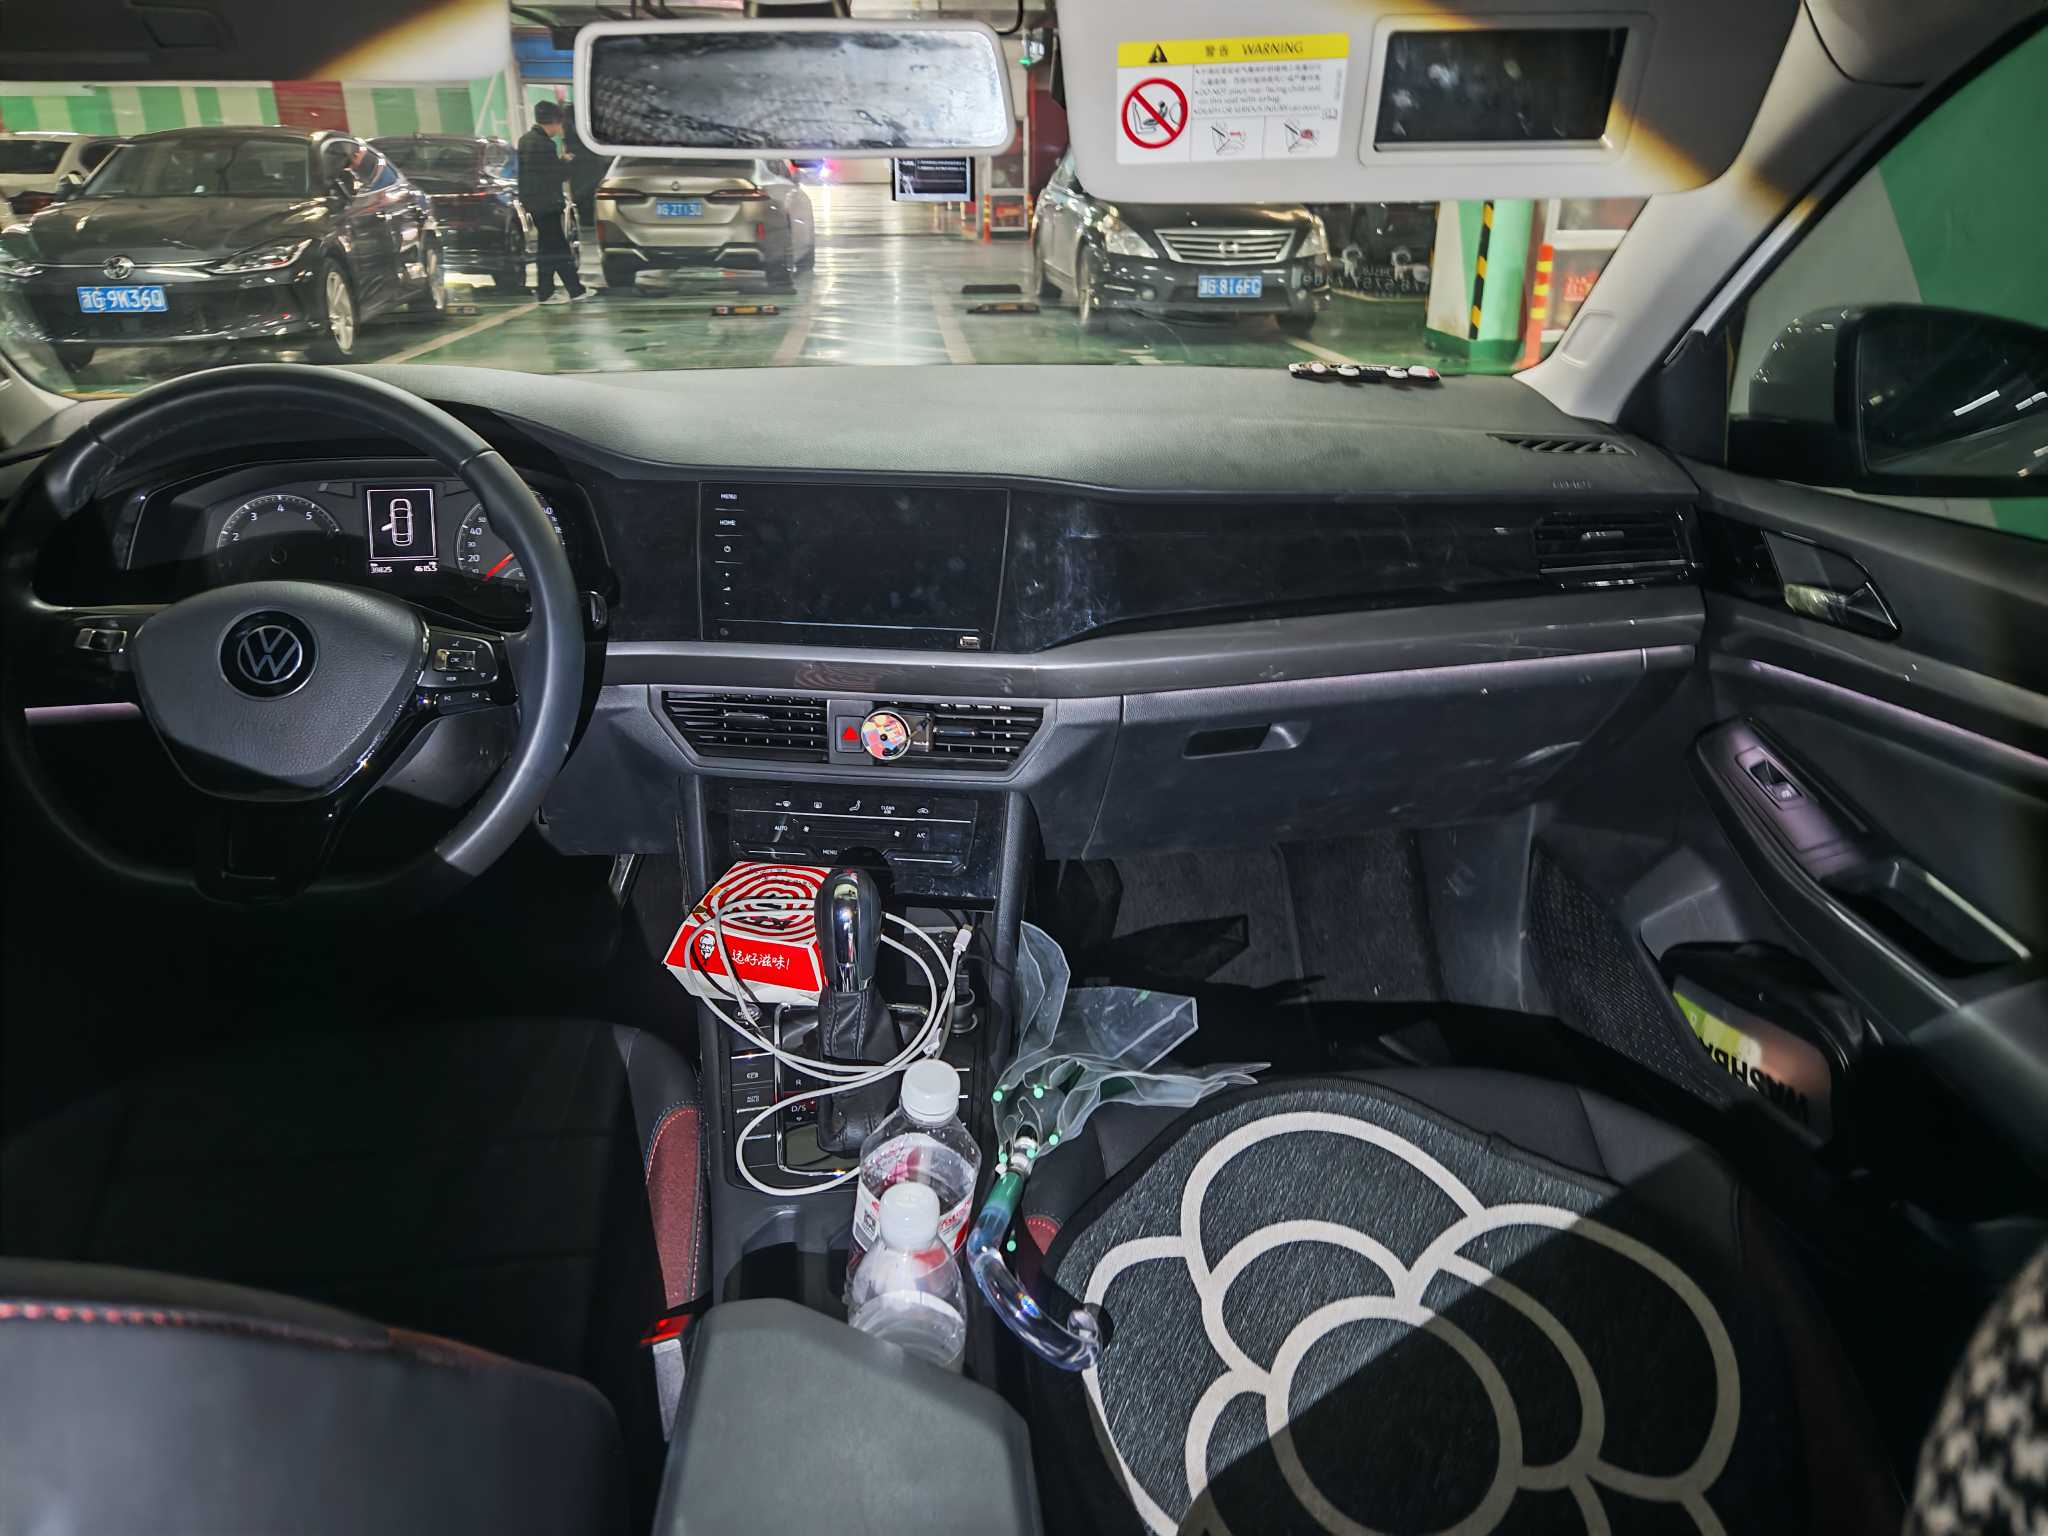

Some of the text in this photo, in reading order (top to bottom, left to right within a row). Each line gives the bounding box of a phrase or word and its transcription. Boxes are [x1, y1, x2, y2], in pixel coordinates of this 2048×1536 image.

[1241, 42, 1304, 56] WARNING
[277, 503, 285, 512] 4
[250, 512, 257, 521] 3
[305, 511, 313, 520] 5
[469, 527, 482, 535] 40
[232, 532, 240, 541] 2
[467, 554, 480, 562] 20
[791, 1104, 807, 1113] D/S
